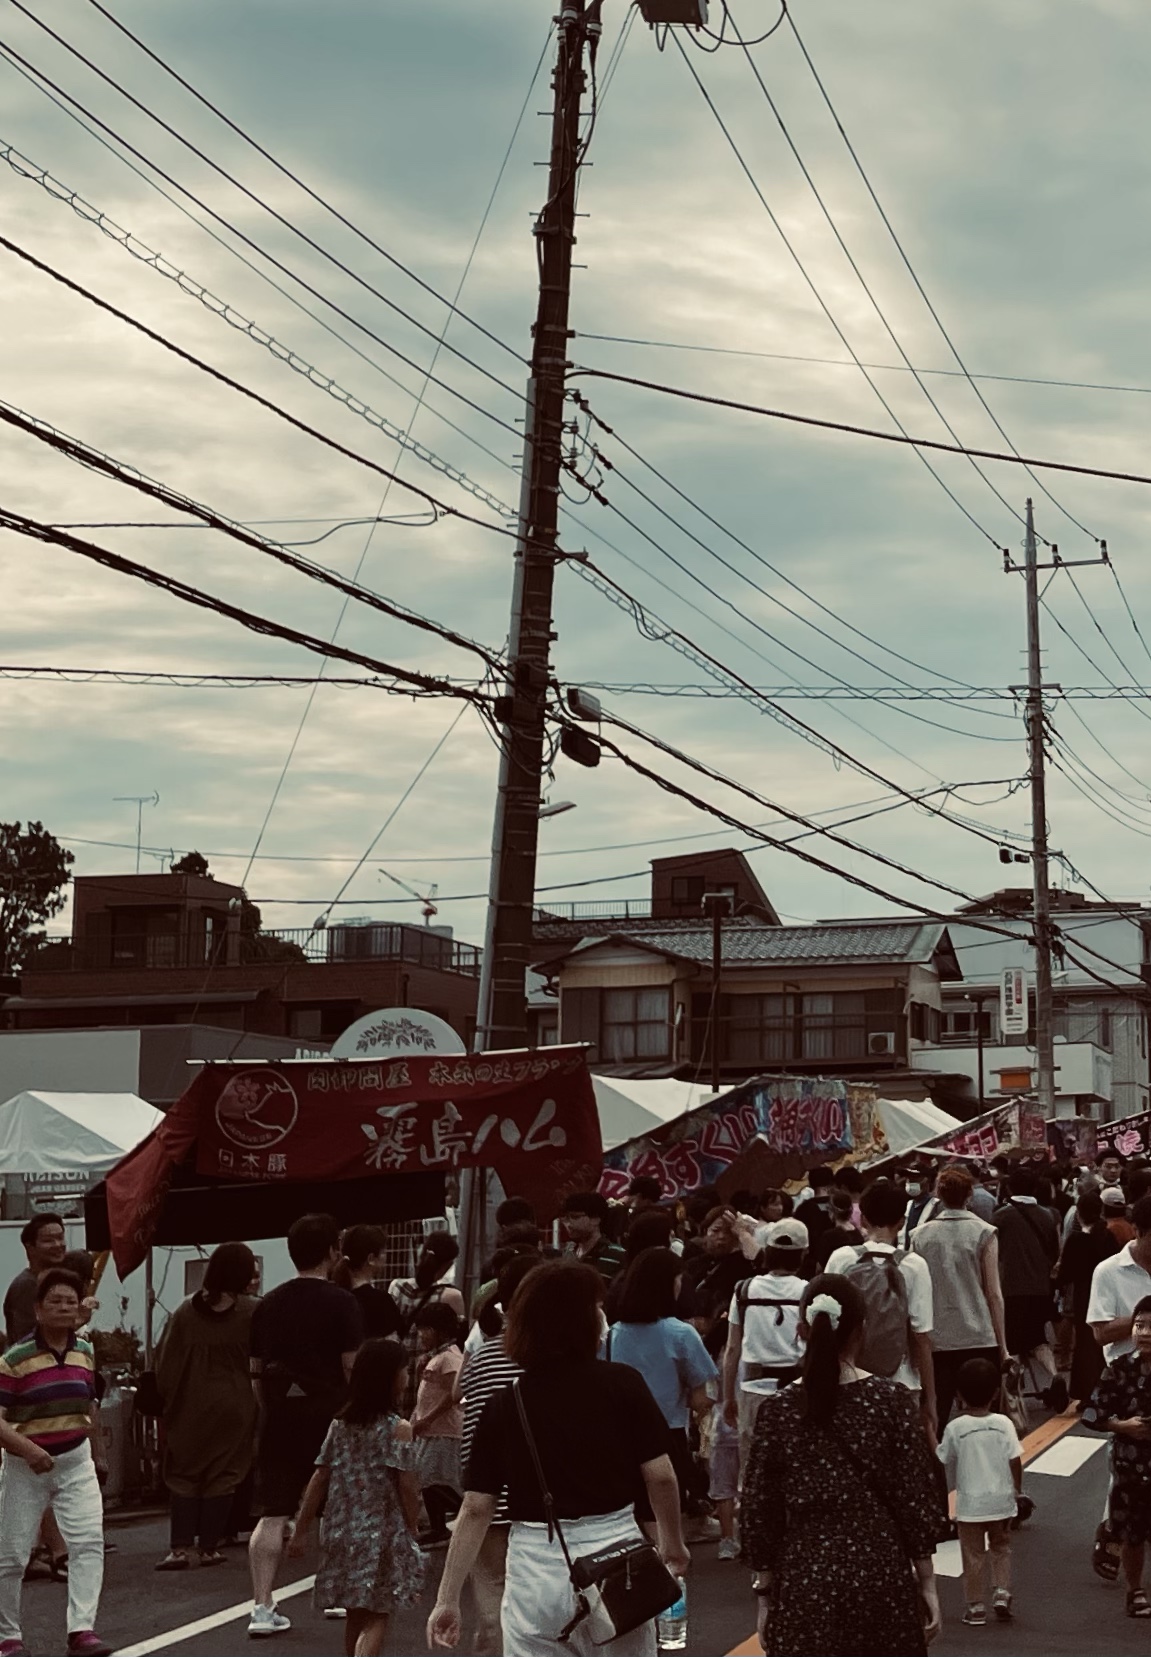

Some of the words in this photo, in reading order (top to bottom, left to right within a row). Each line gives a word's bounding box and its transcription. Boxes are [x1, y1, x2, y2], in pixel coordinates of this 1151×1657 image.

[360, 1098, 567, 1170] 霧島ハム
[218, 1148, 287, 1173] 日本豚
